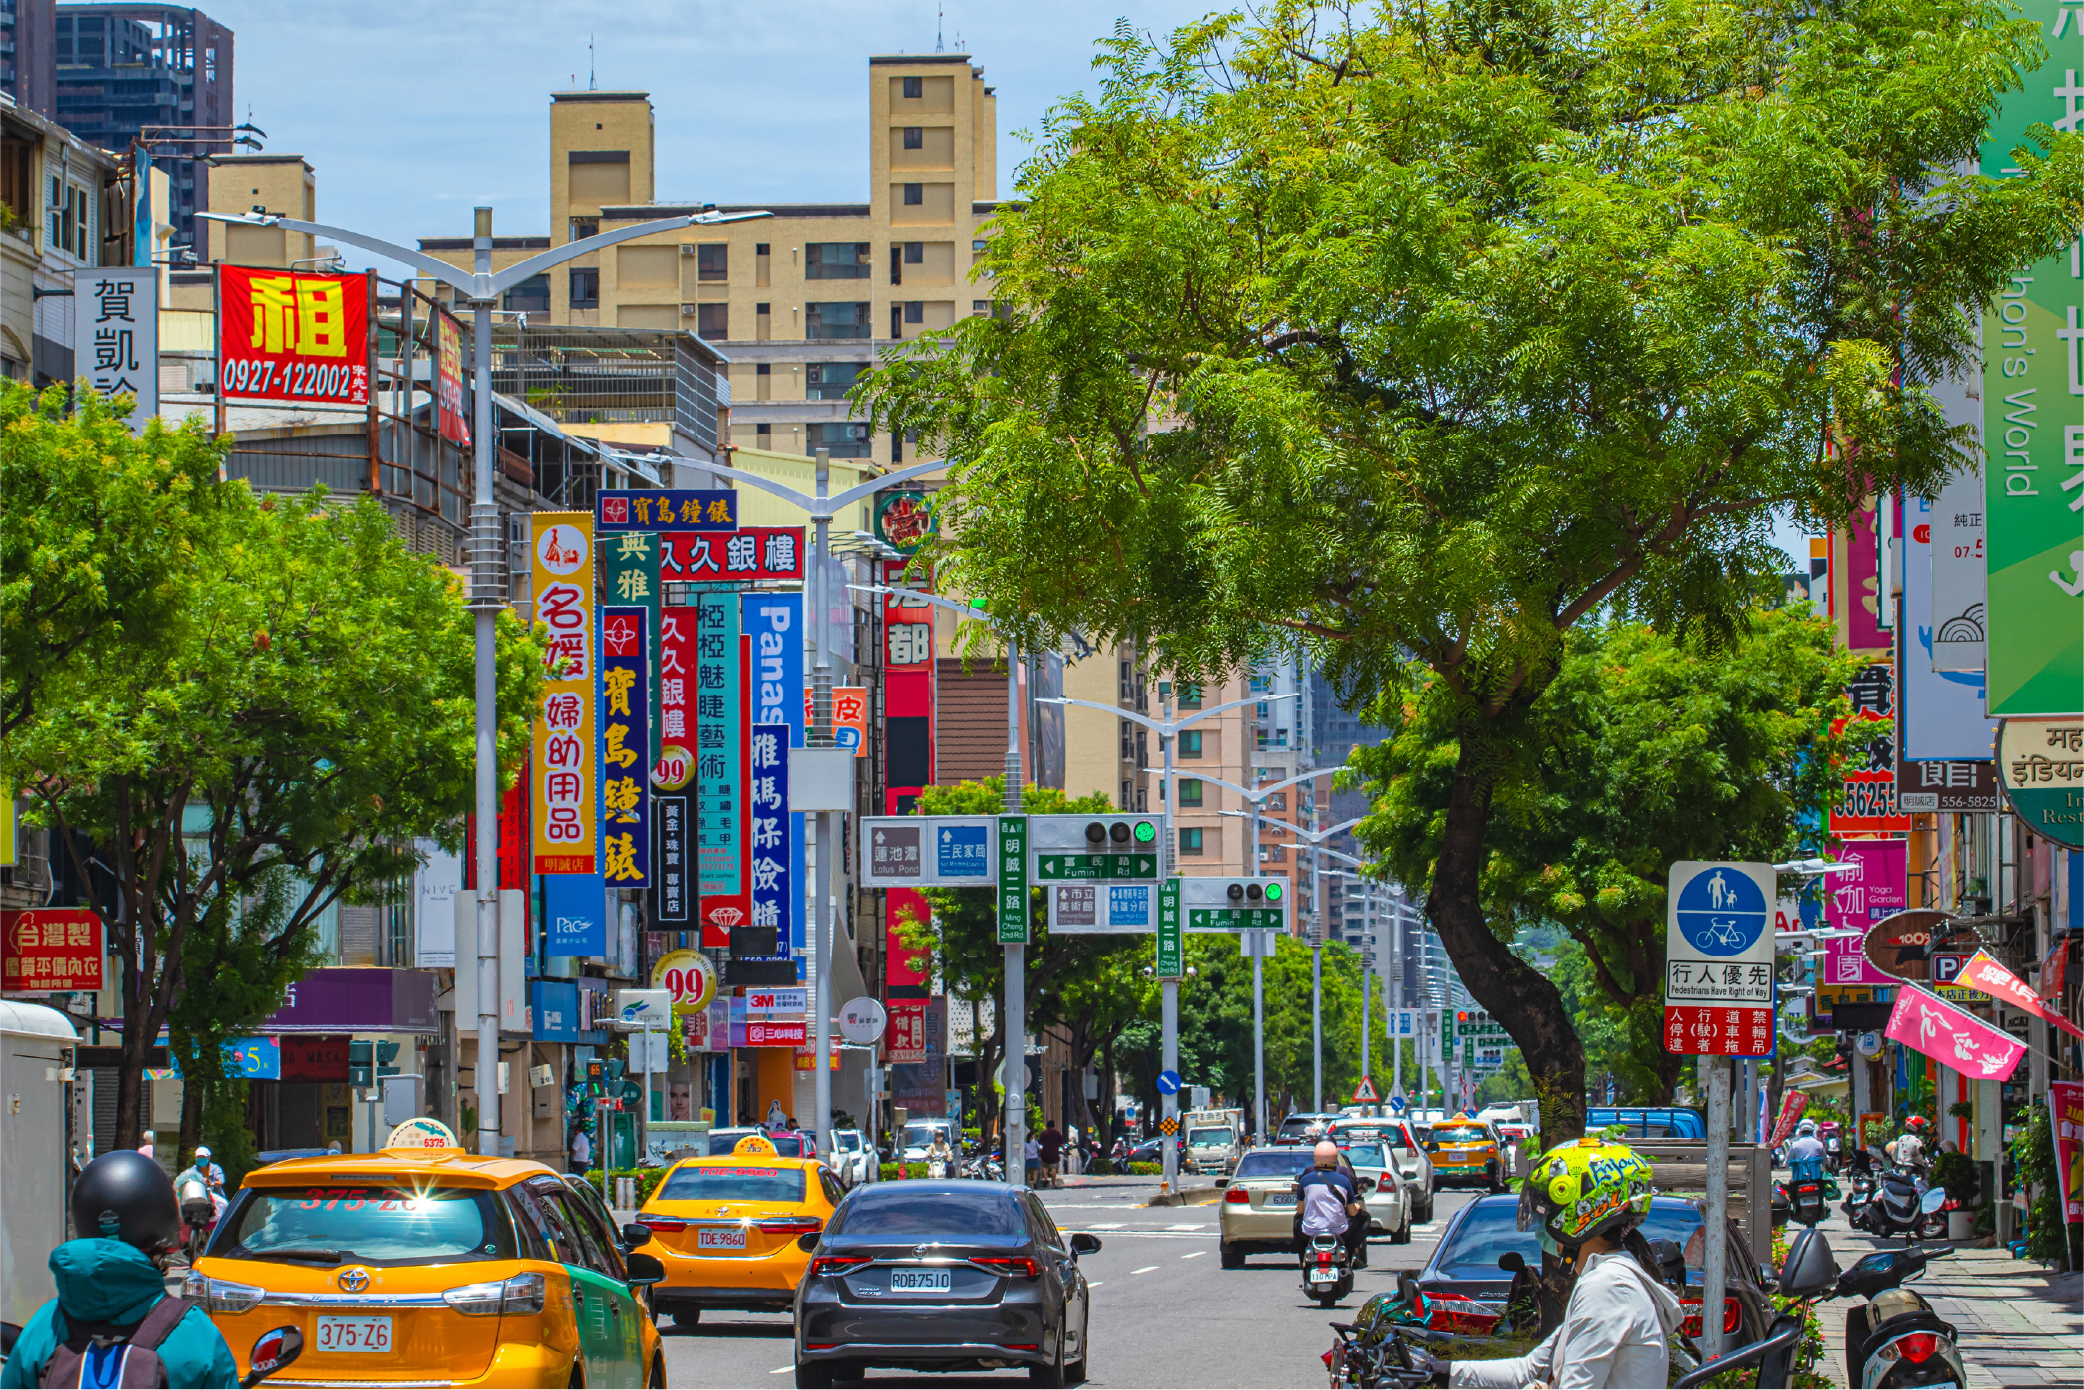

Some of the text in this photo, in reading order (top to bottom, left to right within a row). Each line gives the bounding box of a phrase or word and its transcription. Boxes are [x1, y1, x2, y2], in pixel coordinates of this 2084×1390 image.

[249, 277, 347, 357] 租
[223, 358, 350, 397] 0927-122002
[2006, 388, 2039, 496] World
[1942, 796, 1996, 808] 556-5825
[874, 846, 918, 862] 蓮池潭
[940, 844, 986, 859] 三民家商
[544, 858, 584, 872] 明誠店
[873, 865, 919, 874] Lotus Pond
[1005, 839, 1020, 910] 明誠二路
[1064, 868, 1095, 877] Fumin
[1072, 889, 1094, 900] 市立
[1869, 886, 1893, 894] Yoga
[1058, 901, 1094, 912] 美術館
[1111, 901, 1148, 912] 高雄分院
[1869, 895, 1903, 904] Garden
[1005, 914, 1021, 922] Ming
[1163, 896, 1175, 951] 明誠二路
[1002, 923, 1023, 931] Cheng
[17, 922, 91, 947] 台灣製
[1001, 931, 1013, 939] 2nd
[5, 956, 98, 977] 優質平價內衣
[1940, 958, 1957, 979] P
[1672, 964, 1768, 985] 行人優先
[665, 968, 704, 1004] 99
[1671, 985, 1768, 998] Pedestrians Have Right of Way
[751, 994, 774, 1007] 3M
[1670, 1008, 1767, 1024] 人行道禁
[1669, 1038, 1765, 1053] 違者拖吊
[424, 1138, 445, 1148] 6375
[699, 1167, 778, 1177] TDE-9860
[700, 1232, 746, 1246] TDE-9860
[892, 1273, 949, 1288] RDB-7510
[320, 1323, 388, 1347] 375-Z6
